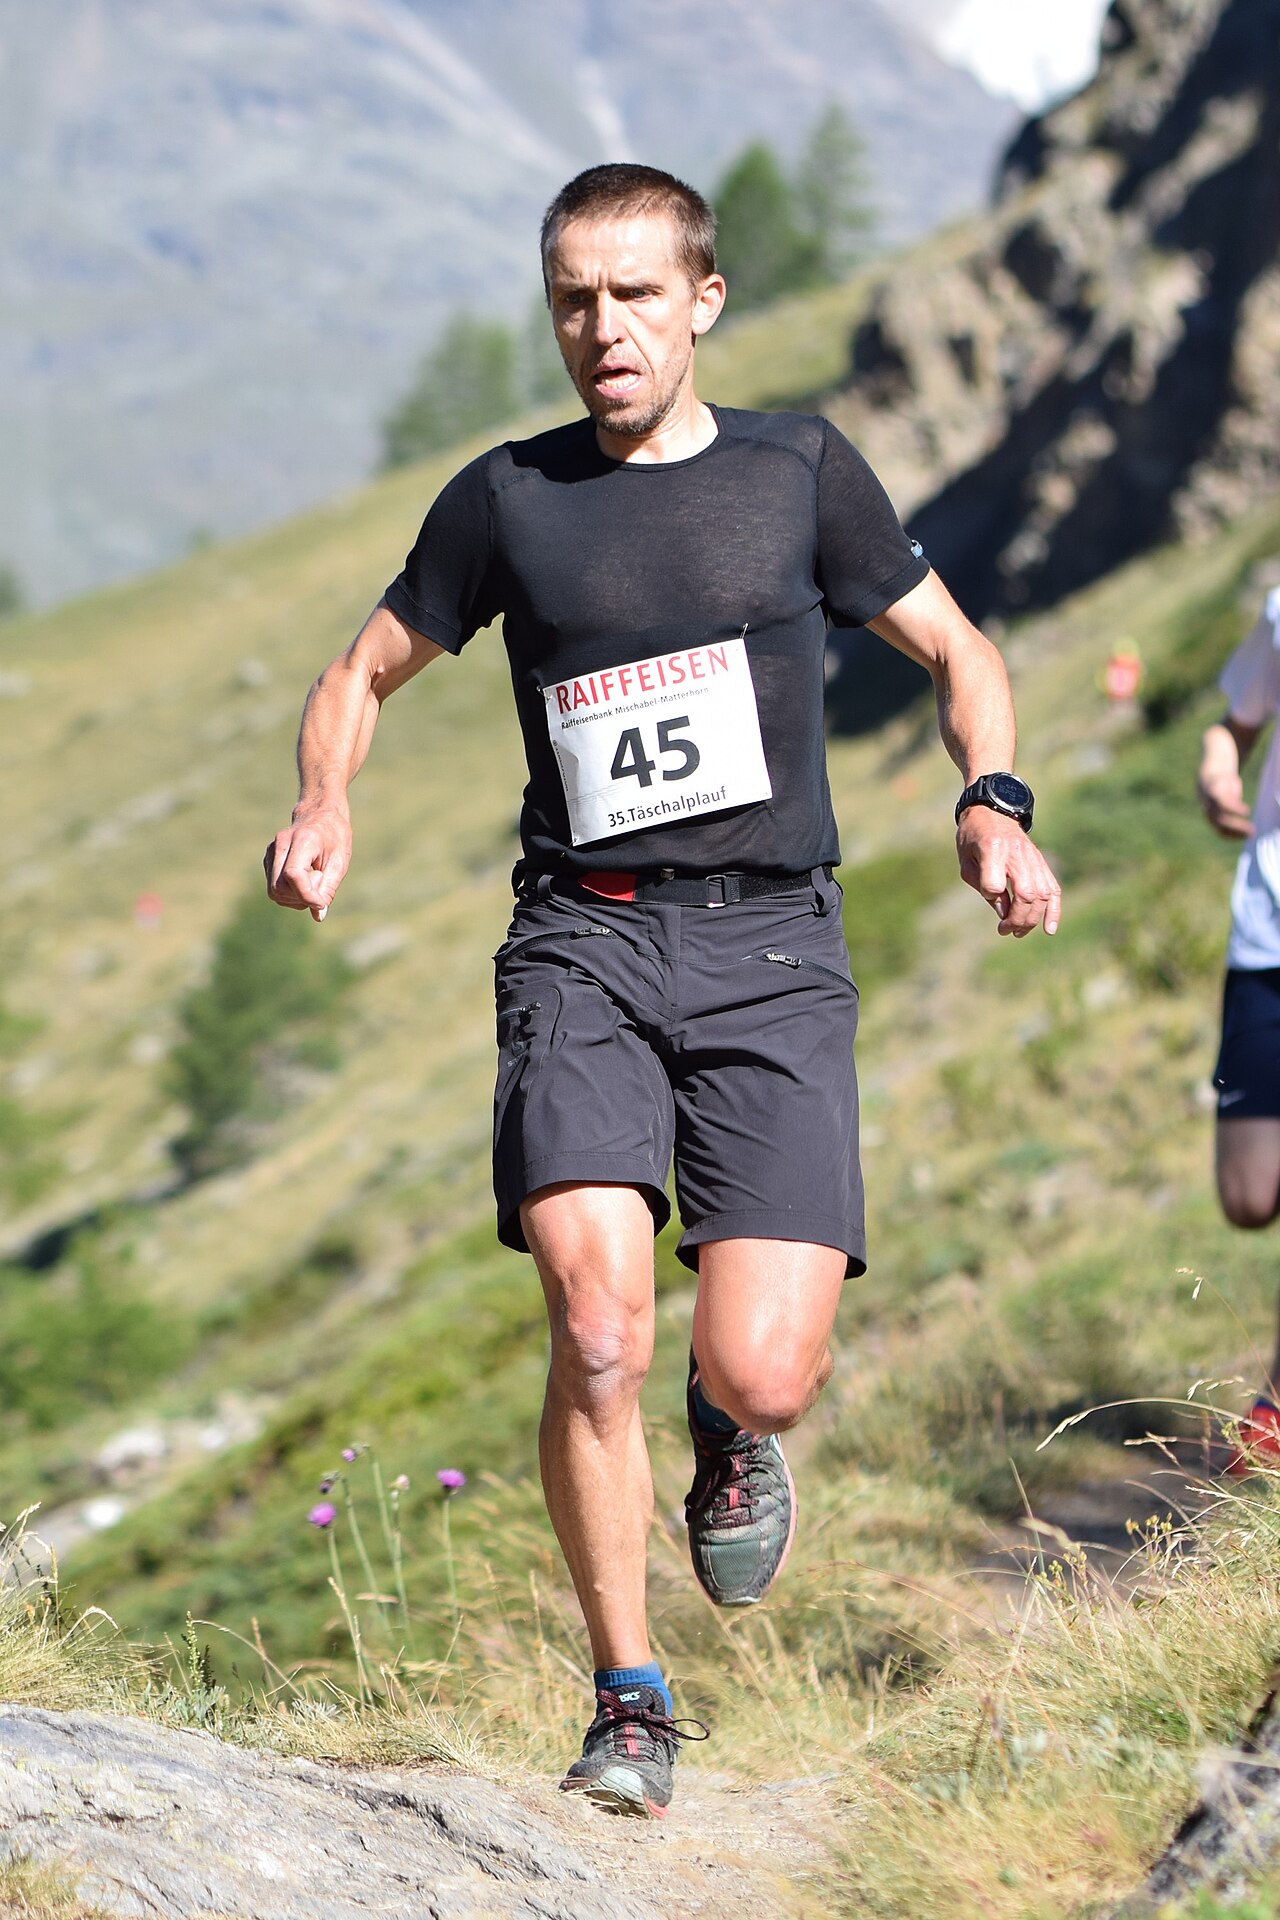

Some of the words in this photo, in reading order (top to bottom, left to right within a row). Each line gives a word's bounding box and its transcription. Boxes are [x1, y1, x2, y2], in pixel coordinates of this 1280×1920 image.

[556, 646, 729, 715] RAIFFEISEN
[561, 709, 613, 730] Raiffeisenbank
[615, 687, 709, 715] Mischabel-Matterhorn
[610, 715, 700, 788] 45
[608, 785, 727, 827] 35.Täschalplauf
